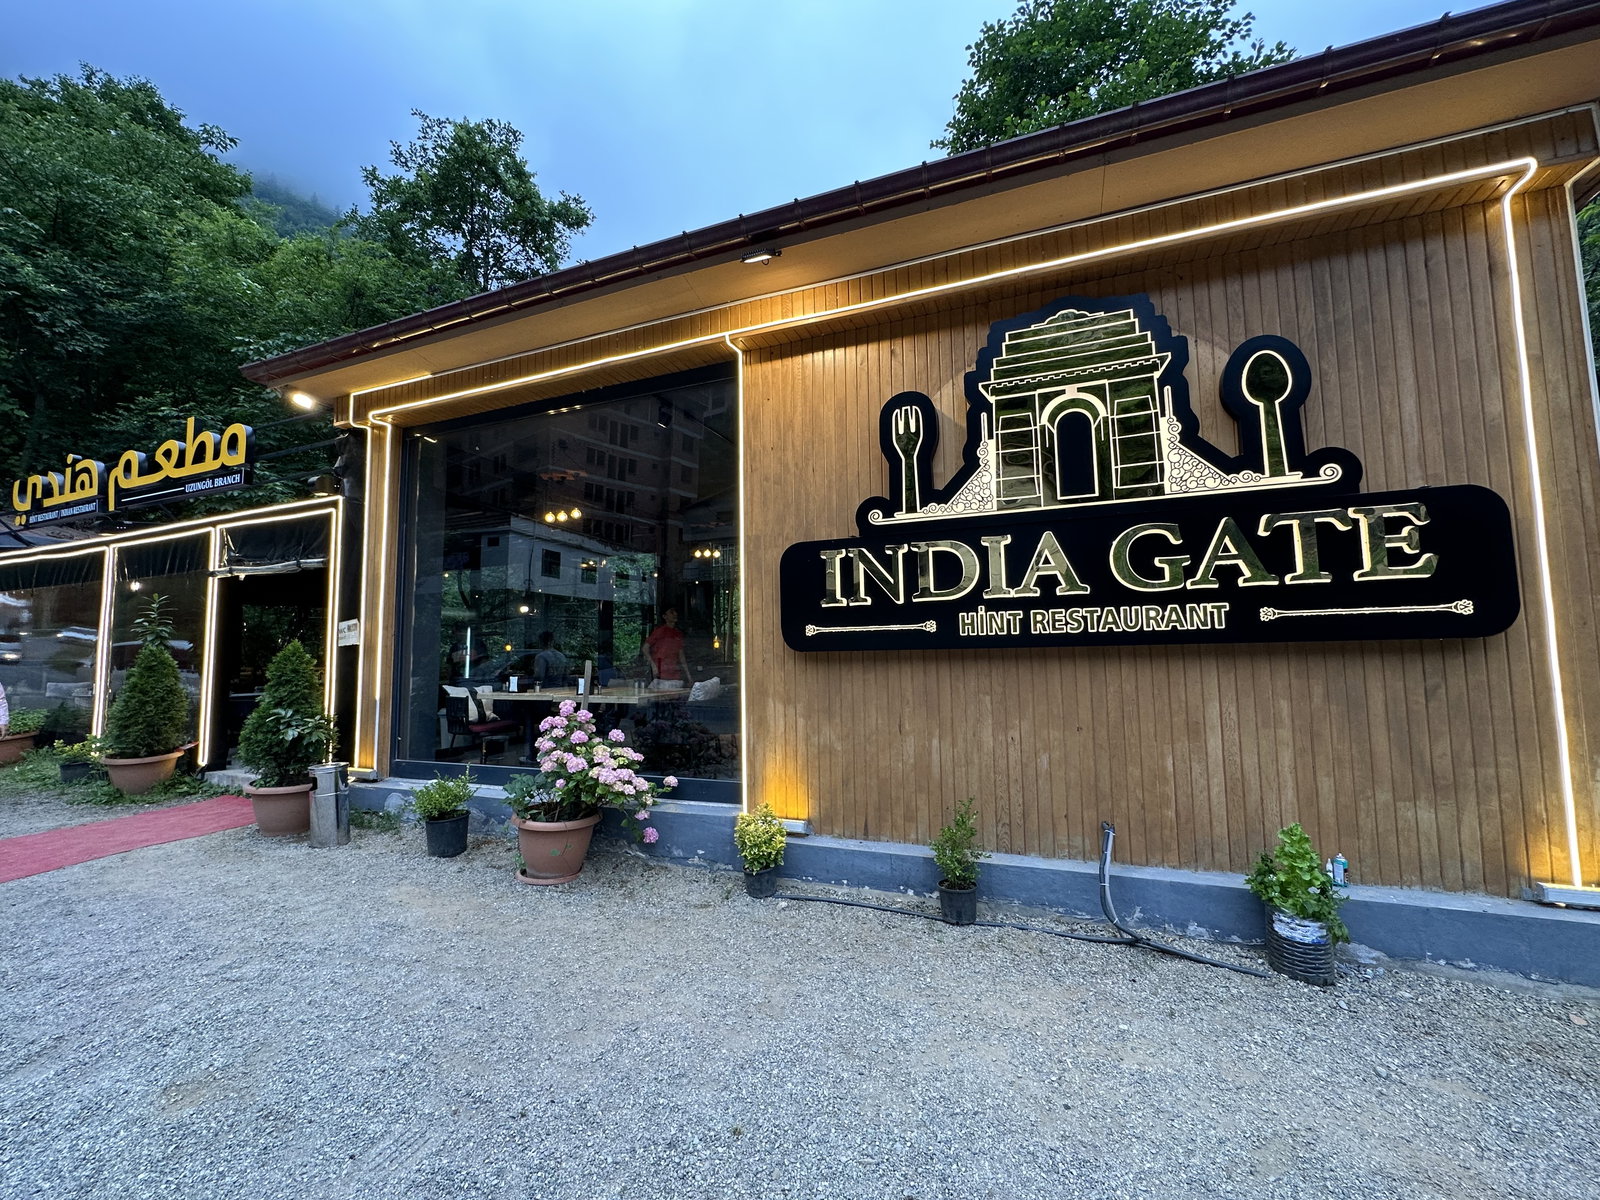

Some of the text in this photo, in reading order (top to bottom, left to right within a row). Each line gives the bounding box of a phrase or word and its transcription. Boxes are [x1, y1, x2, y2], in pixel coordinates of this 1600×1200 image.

[13, 417, 247, 526] مطعم هندي
[185, 474, 240, 492] UZUNGÖL BRANCH
[820, 502, 1440, 608] INDIA GATE
[1030, 603, 1229, 634] RESTAURANT
